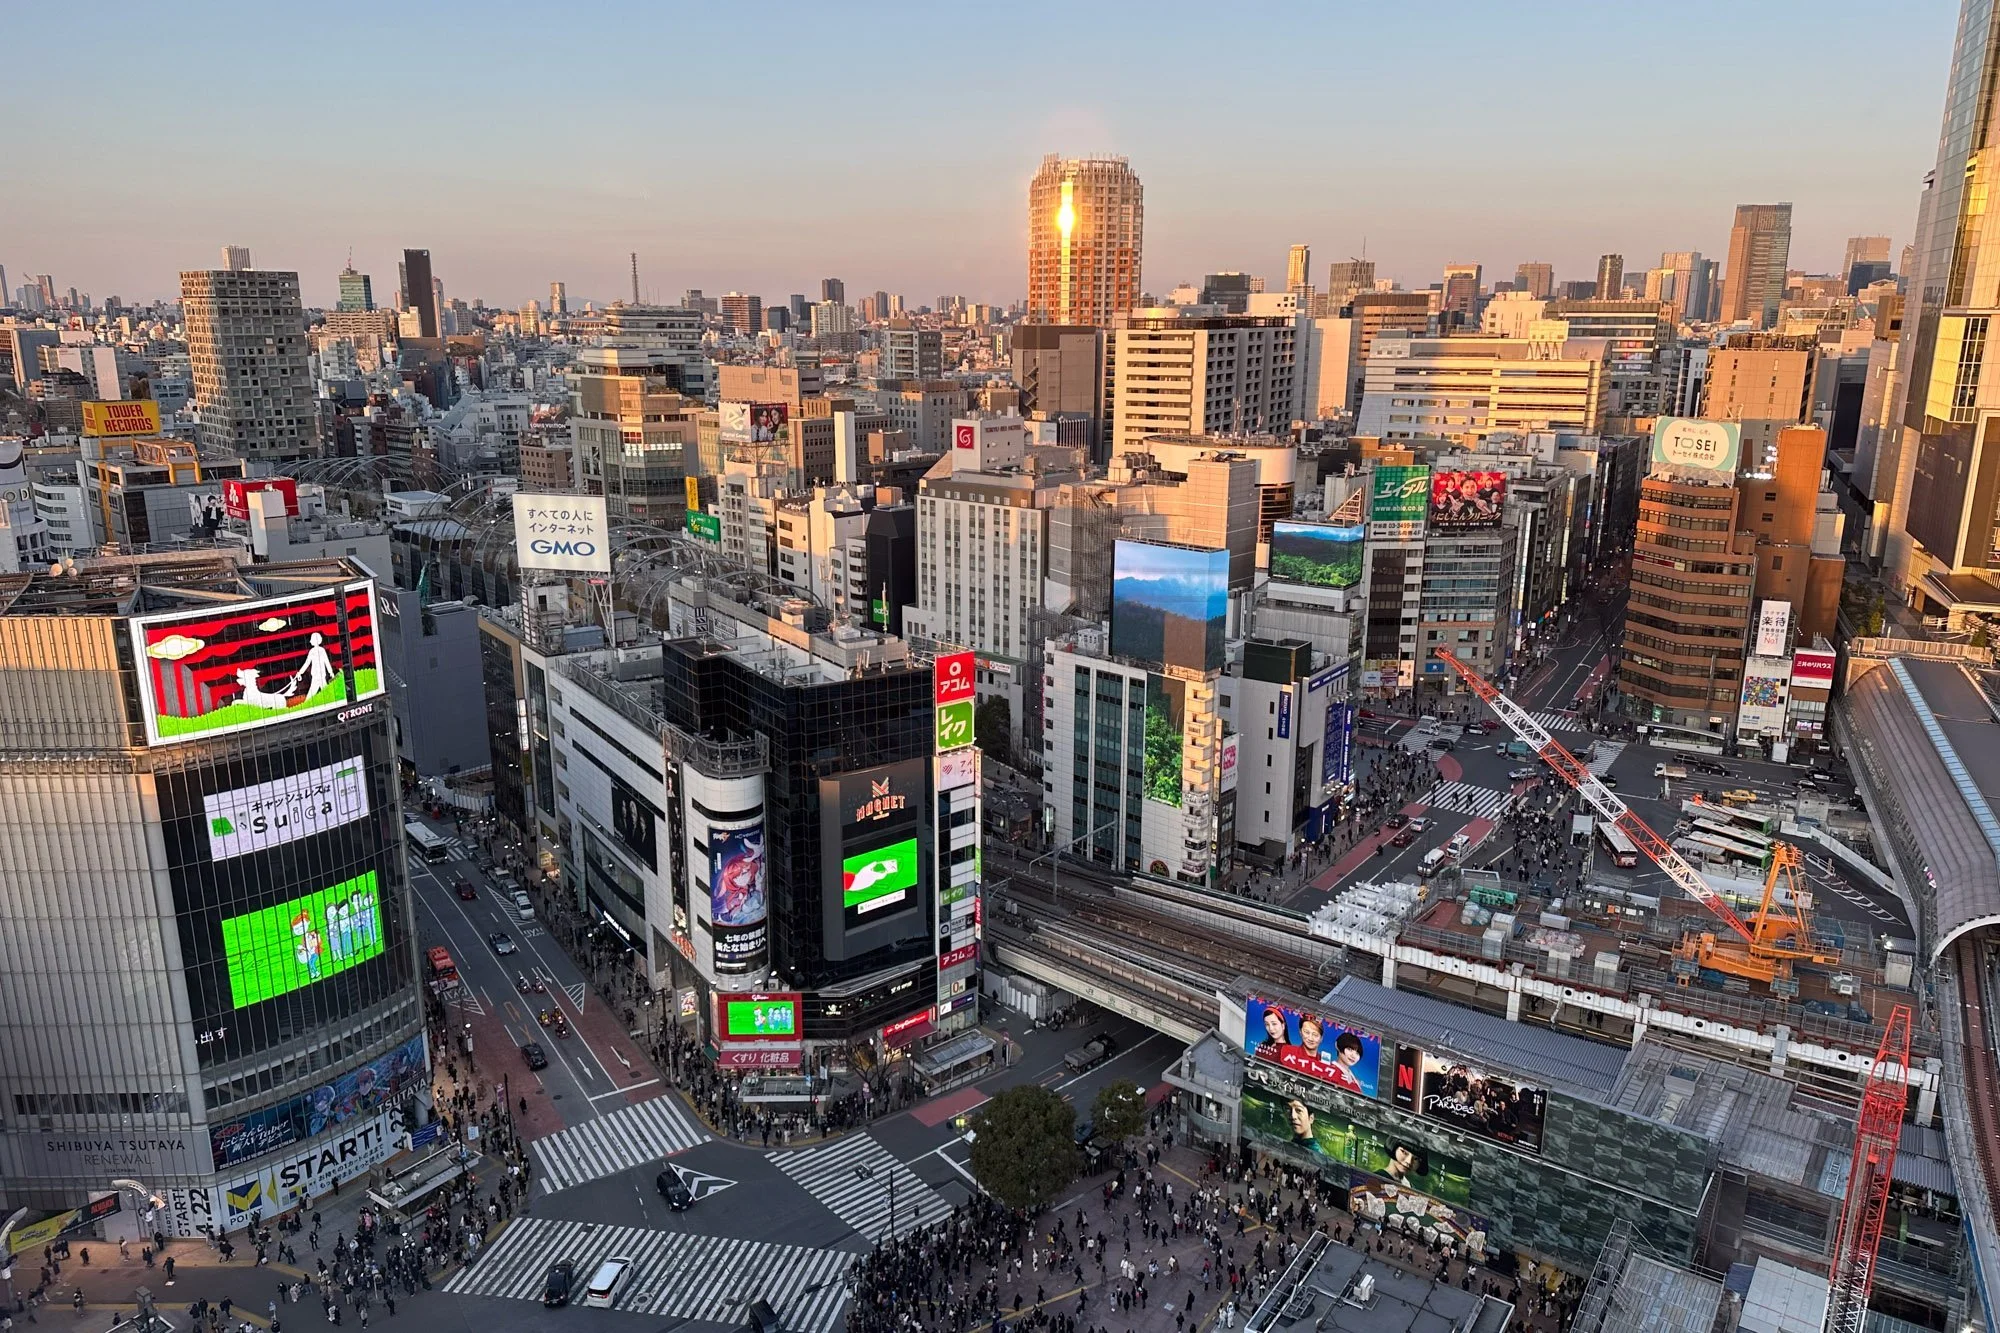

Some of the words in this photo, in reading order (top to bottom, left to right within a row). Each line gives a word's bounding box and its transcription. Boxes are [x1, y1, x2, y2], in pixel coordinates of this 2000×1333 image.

[105, 404, 144, 418] TOWER
[104, 417, 153, 433] RECORDS
[527, 508, 593, 521] すべての人に
[529, 522, 594, 536] インターネット
[530, 539, 596, 557] GMO
[1762, 616, 1786, 628] 楽待
[1797, 661, 1832, 670] 三井のリハウス
[940, 676, 971, 695] アコム
[337, 703, 374, 722] QFRONT
[940, 709, 967, 740] レイク
[251, 784, 331, 813] キャッシュレスは
[252, 801, 333, 834] Suica
[943, 888, 963, 900] レイク
[942, 951, 966, 966] アコム
[732, 1053, 757, 1063] くすり
[760, 1052, 789, 1063] 化粧品
[1247, 1070, 1269, 1086] JR
[377, 1078, 427, 1114] TSUTAYA
[1423, 1094, 1475, 1115] PARADES
[47, 1140, 113, 1152] SHIBUYA
[119, 1140, 185, 1151] TSUTAYA
[84, 1154, 155, 1166] RENEWAL.
[280, 1122, 382, 1188] START!
[172, 1188, 191, 1237] START!
[188, 1188, 213, 1236] 4.22
